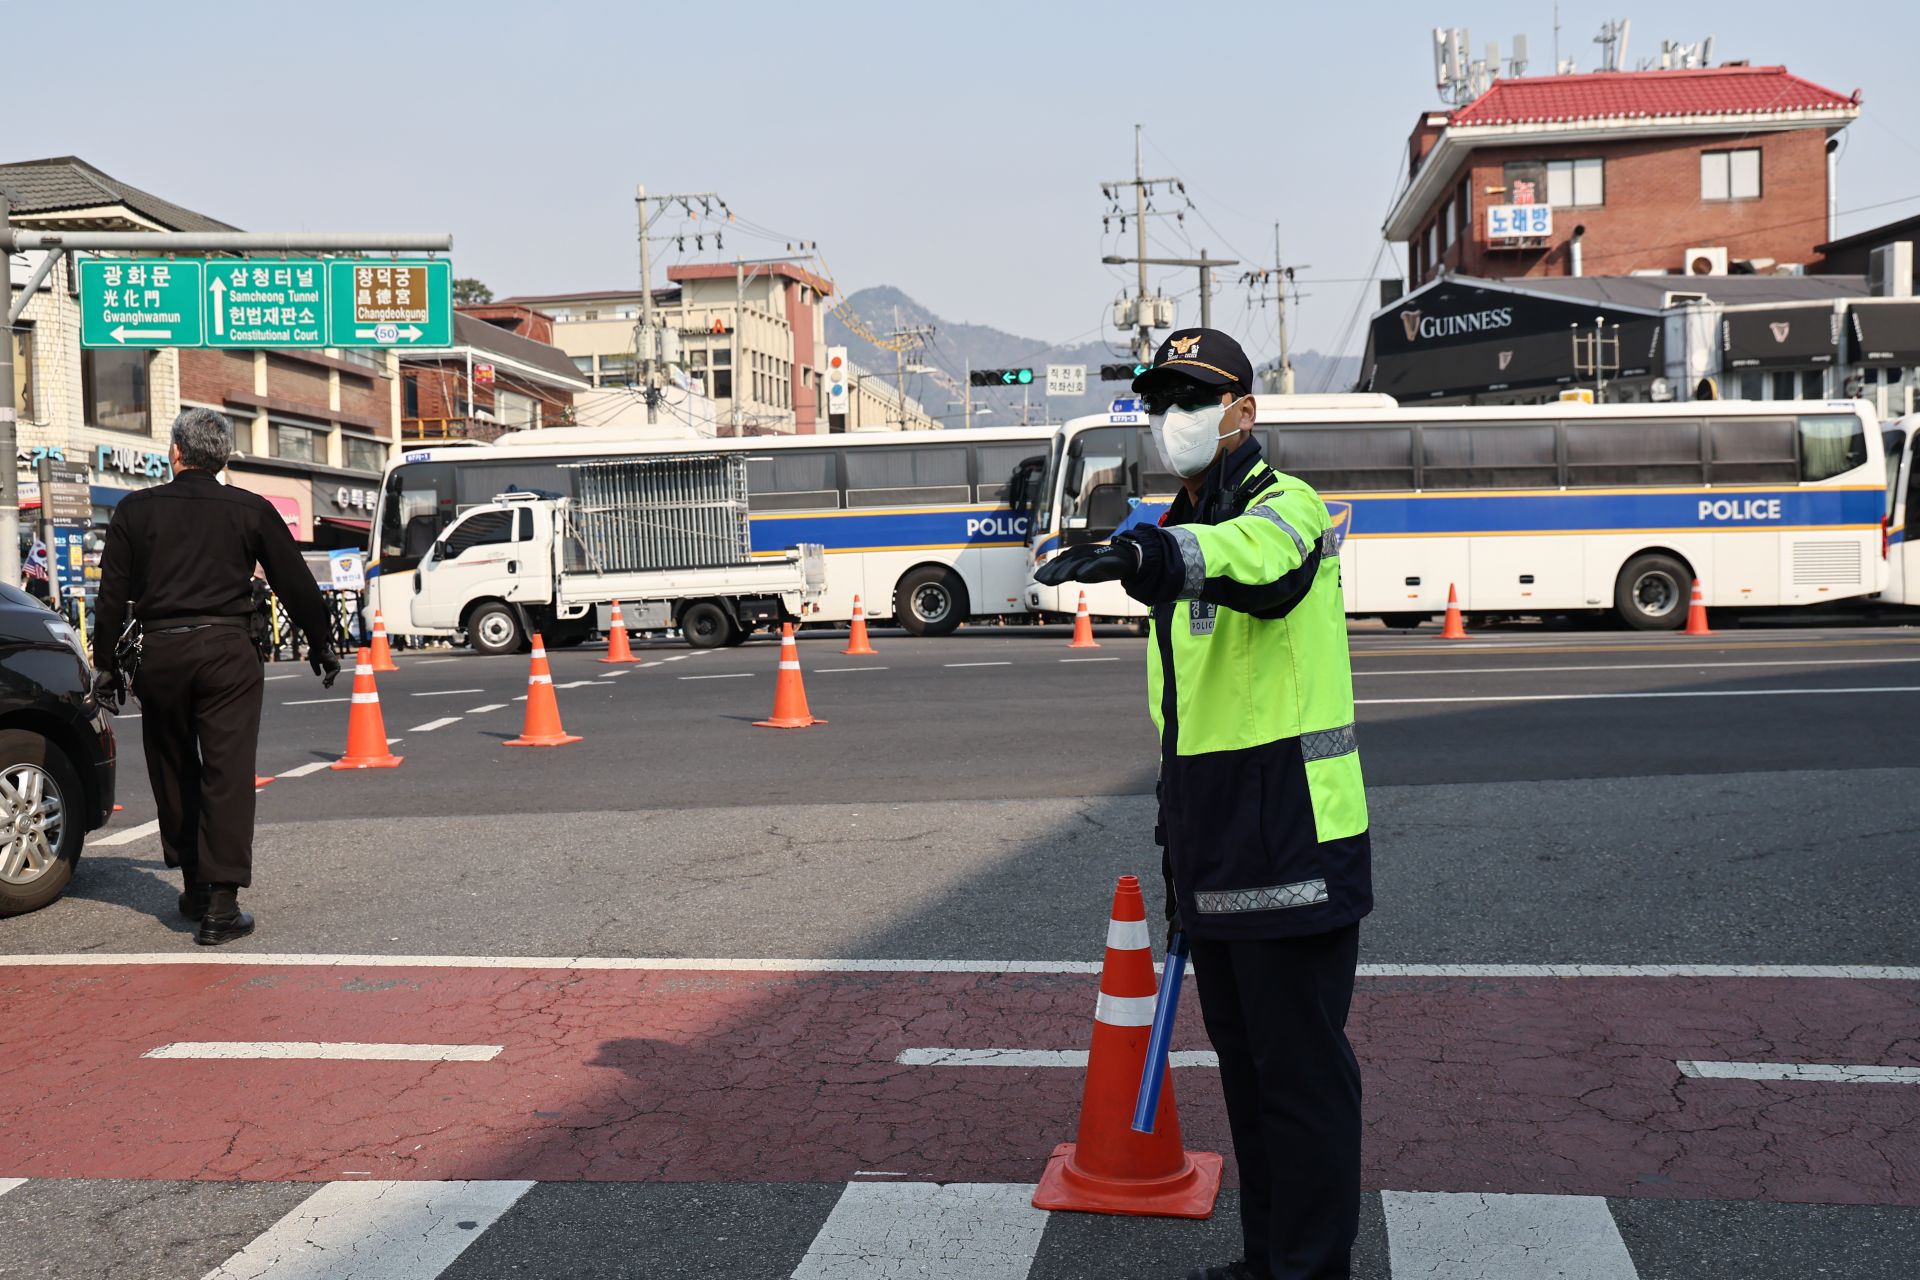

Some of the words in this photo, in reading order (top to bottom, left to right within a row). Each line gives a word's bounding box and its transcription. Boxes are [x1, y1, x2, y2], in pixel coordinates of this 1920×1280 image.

[1492, 207, 1549, 233] 노래방
[102, 264, 172, 288] 광화문
[229, 266, 314, 288] 삼청터널
[357, 267, 412, 288] 창덕궁
[103, 289, 161, 308] 光化門
[229, 289, 285, 305] Samcheong
[287, 289, 319, 302] Tunnel
[103, 310, 181, 326] Gwanghwamun
[228, 306, 316, 326] 헌법재판소
[357, 306, 427, 323] Changdeokgung
[1419, 306, 1513, 339] GUINNESS
[229, 328, 291, 341] Constitutional
[293, 328, 319, 341] Court
[379, 328, 395, 339] 50
[712, 318, 726, 334] A
[112, 447, 163, 478] 지에스25
[1697, 499, 1782, 520] POLICE
[966, 517, 1028, 537] POLIC
[1191, 621, 1215, 631] POLIC
